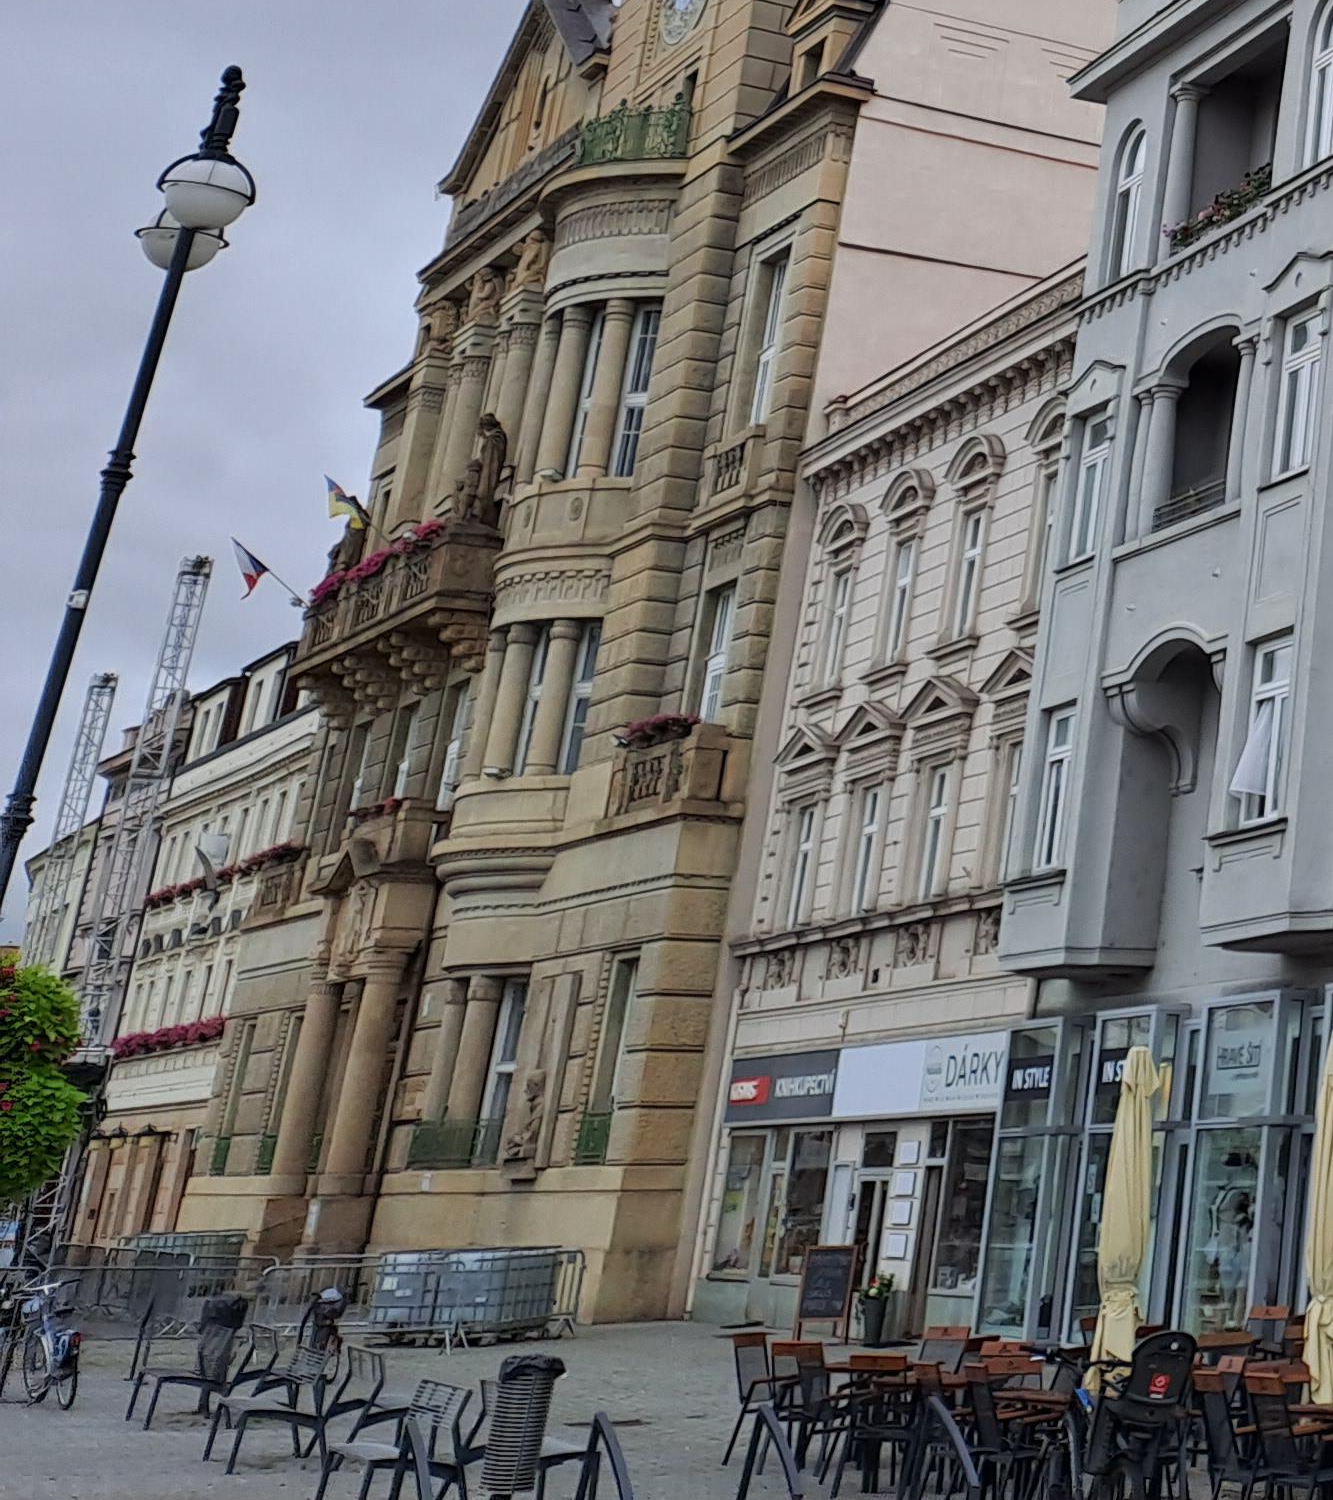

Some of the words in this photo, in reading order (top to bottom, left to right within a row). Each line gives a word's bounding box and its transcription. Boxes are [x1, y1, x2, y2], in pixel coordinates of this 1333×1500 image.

[945, 1044, 1004, 1088] DÁRKY
[1011, 1069, 1023, 1090] IN
[1023, 1066, 1050, 1090] STYLE
